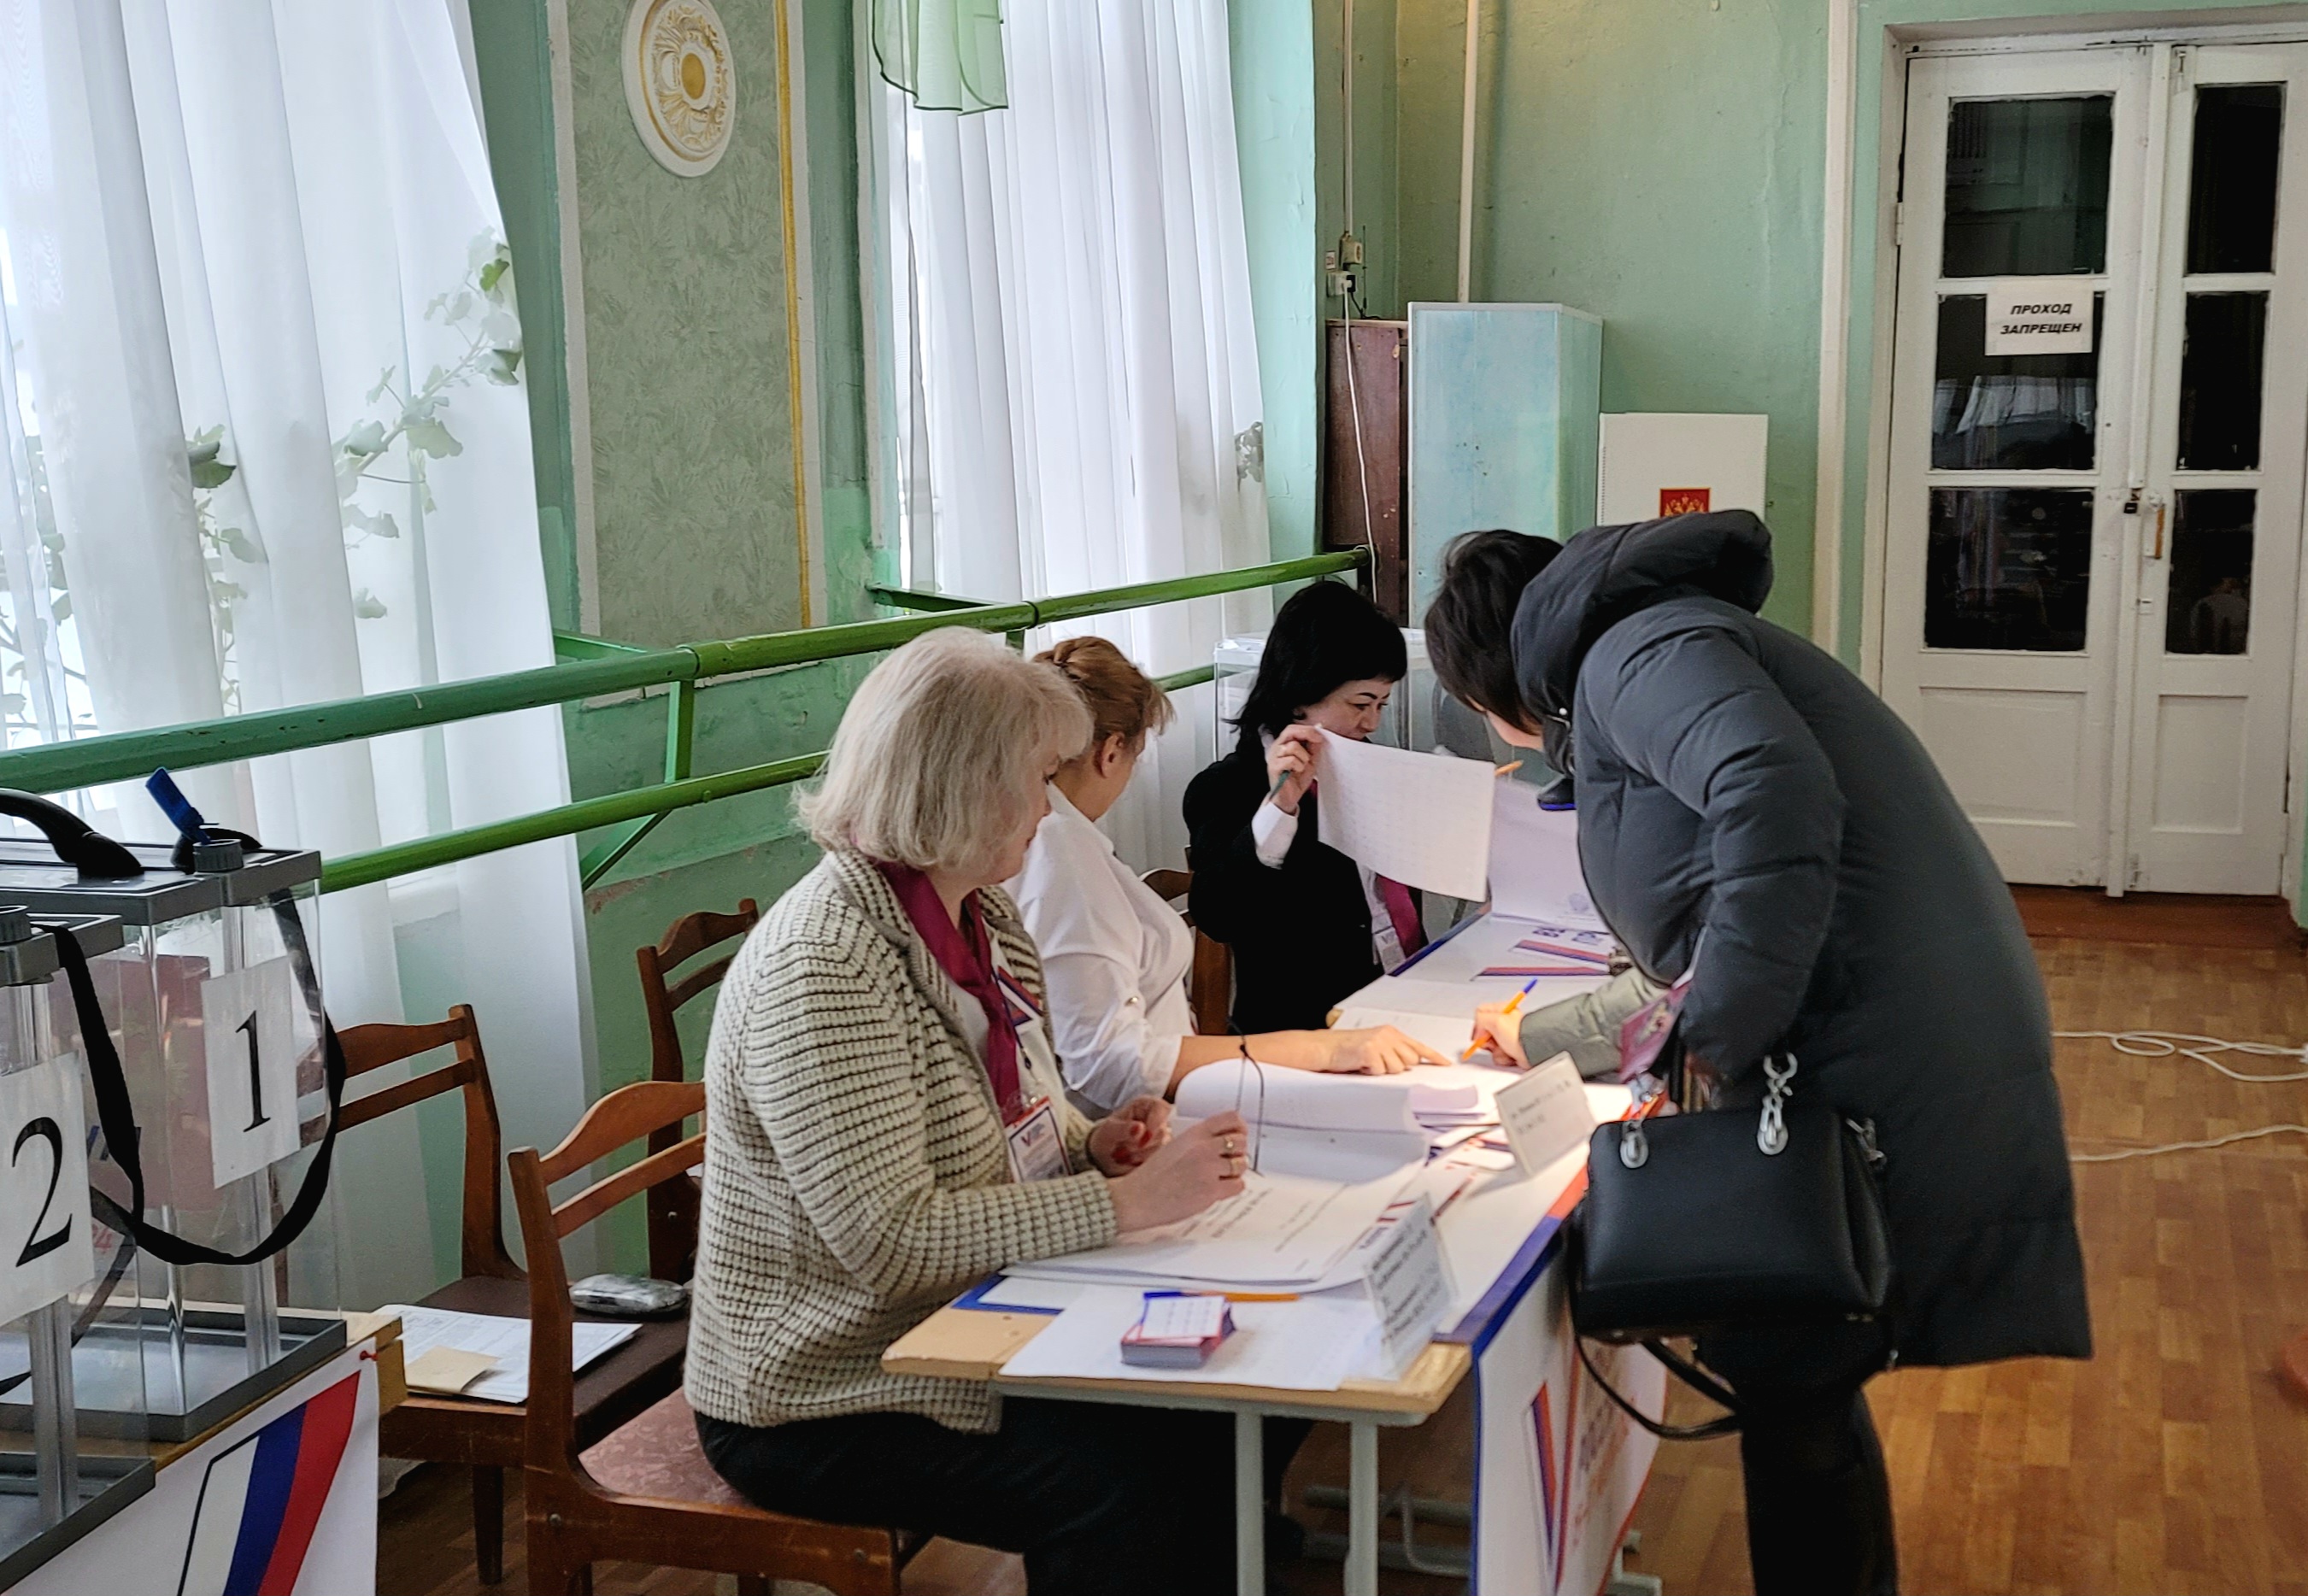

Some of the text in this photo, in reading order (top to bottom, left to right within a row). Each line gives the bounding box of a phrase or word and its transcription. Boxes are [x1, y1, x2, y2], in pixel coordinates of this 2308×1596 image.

[2000, 323, 2082, 335] ЗАПРЕЩЕН
[2011, 303, 2072, 315] ПРОХОД
[235, 1010, 272, 1133] 1
[12, 1116, 73, 1268] 2
